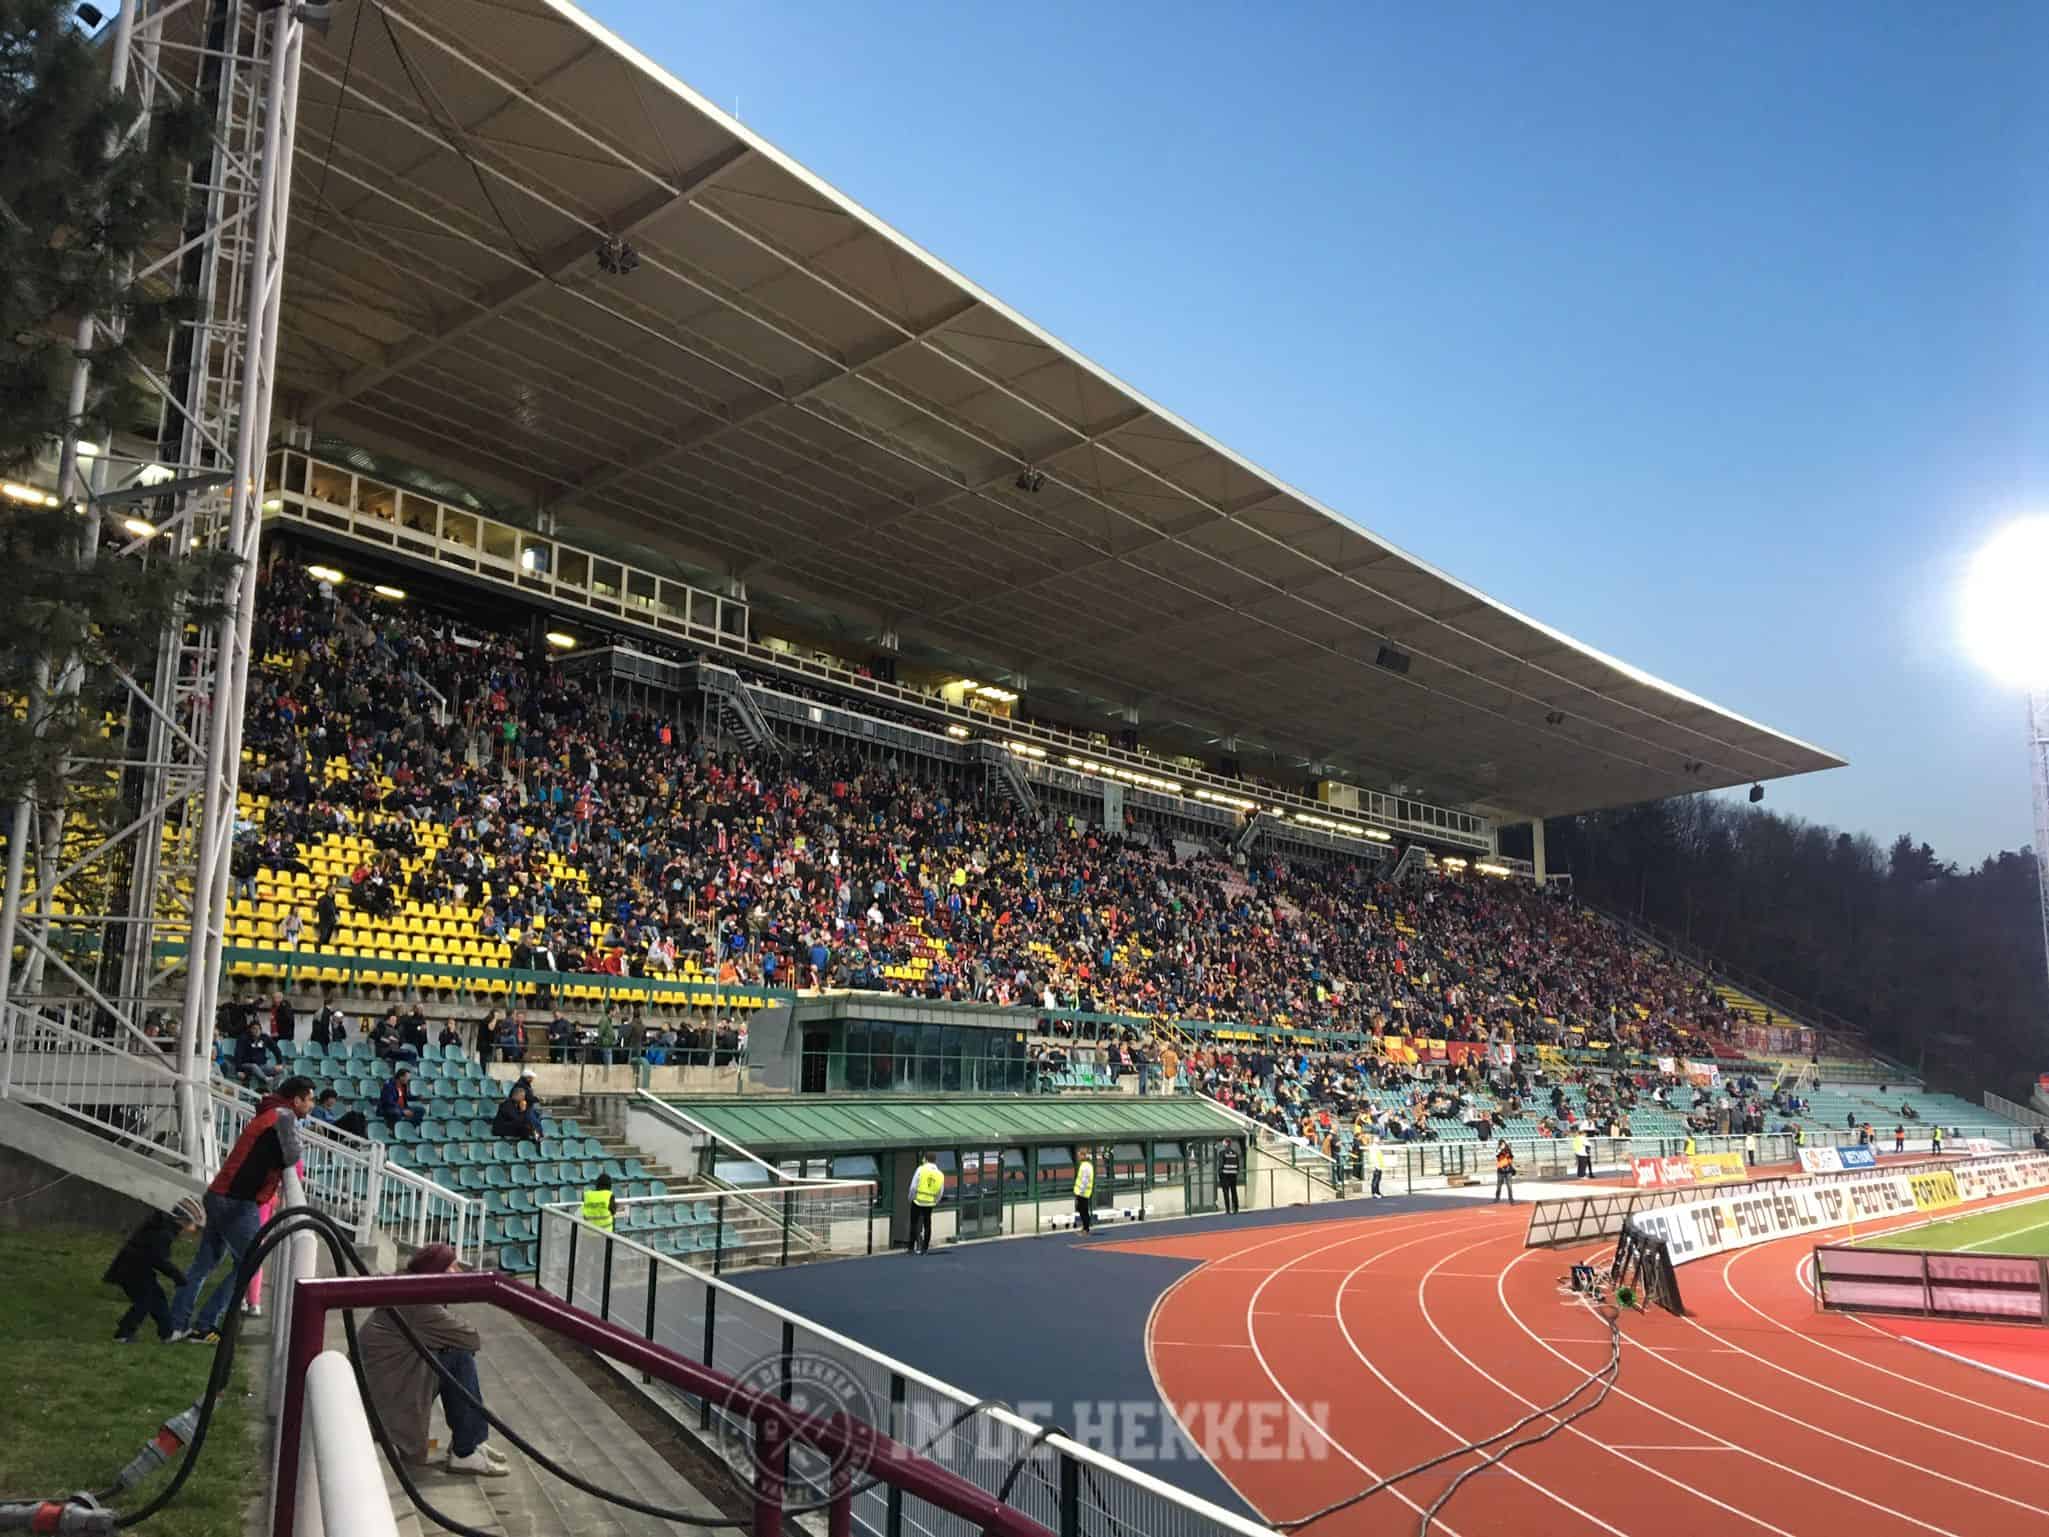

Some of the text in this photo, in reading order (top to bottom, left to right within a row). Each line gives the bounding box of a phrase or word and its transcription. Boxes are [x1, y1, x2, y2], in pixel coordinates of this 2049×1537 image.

[1690, 1205, 1725, 1248] TOP
[1732, 1195, 1818, 1240] FOOTBALL
[1814, 1188, 1843, 1221] TOP
[1849, 1181, 1914, 1215] FOOTBALL
[1910, 1178, 1959, 1206] FORTUNA
